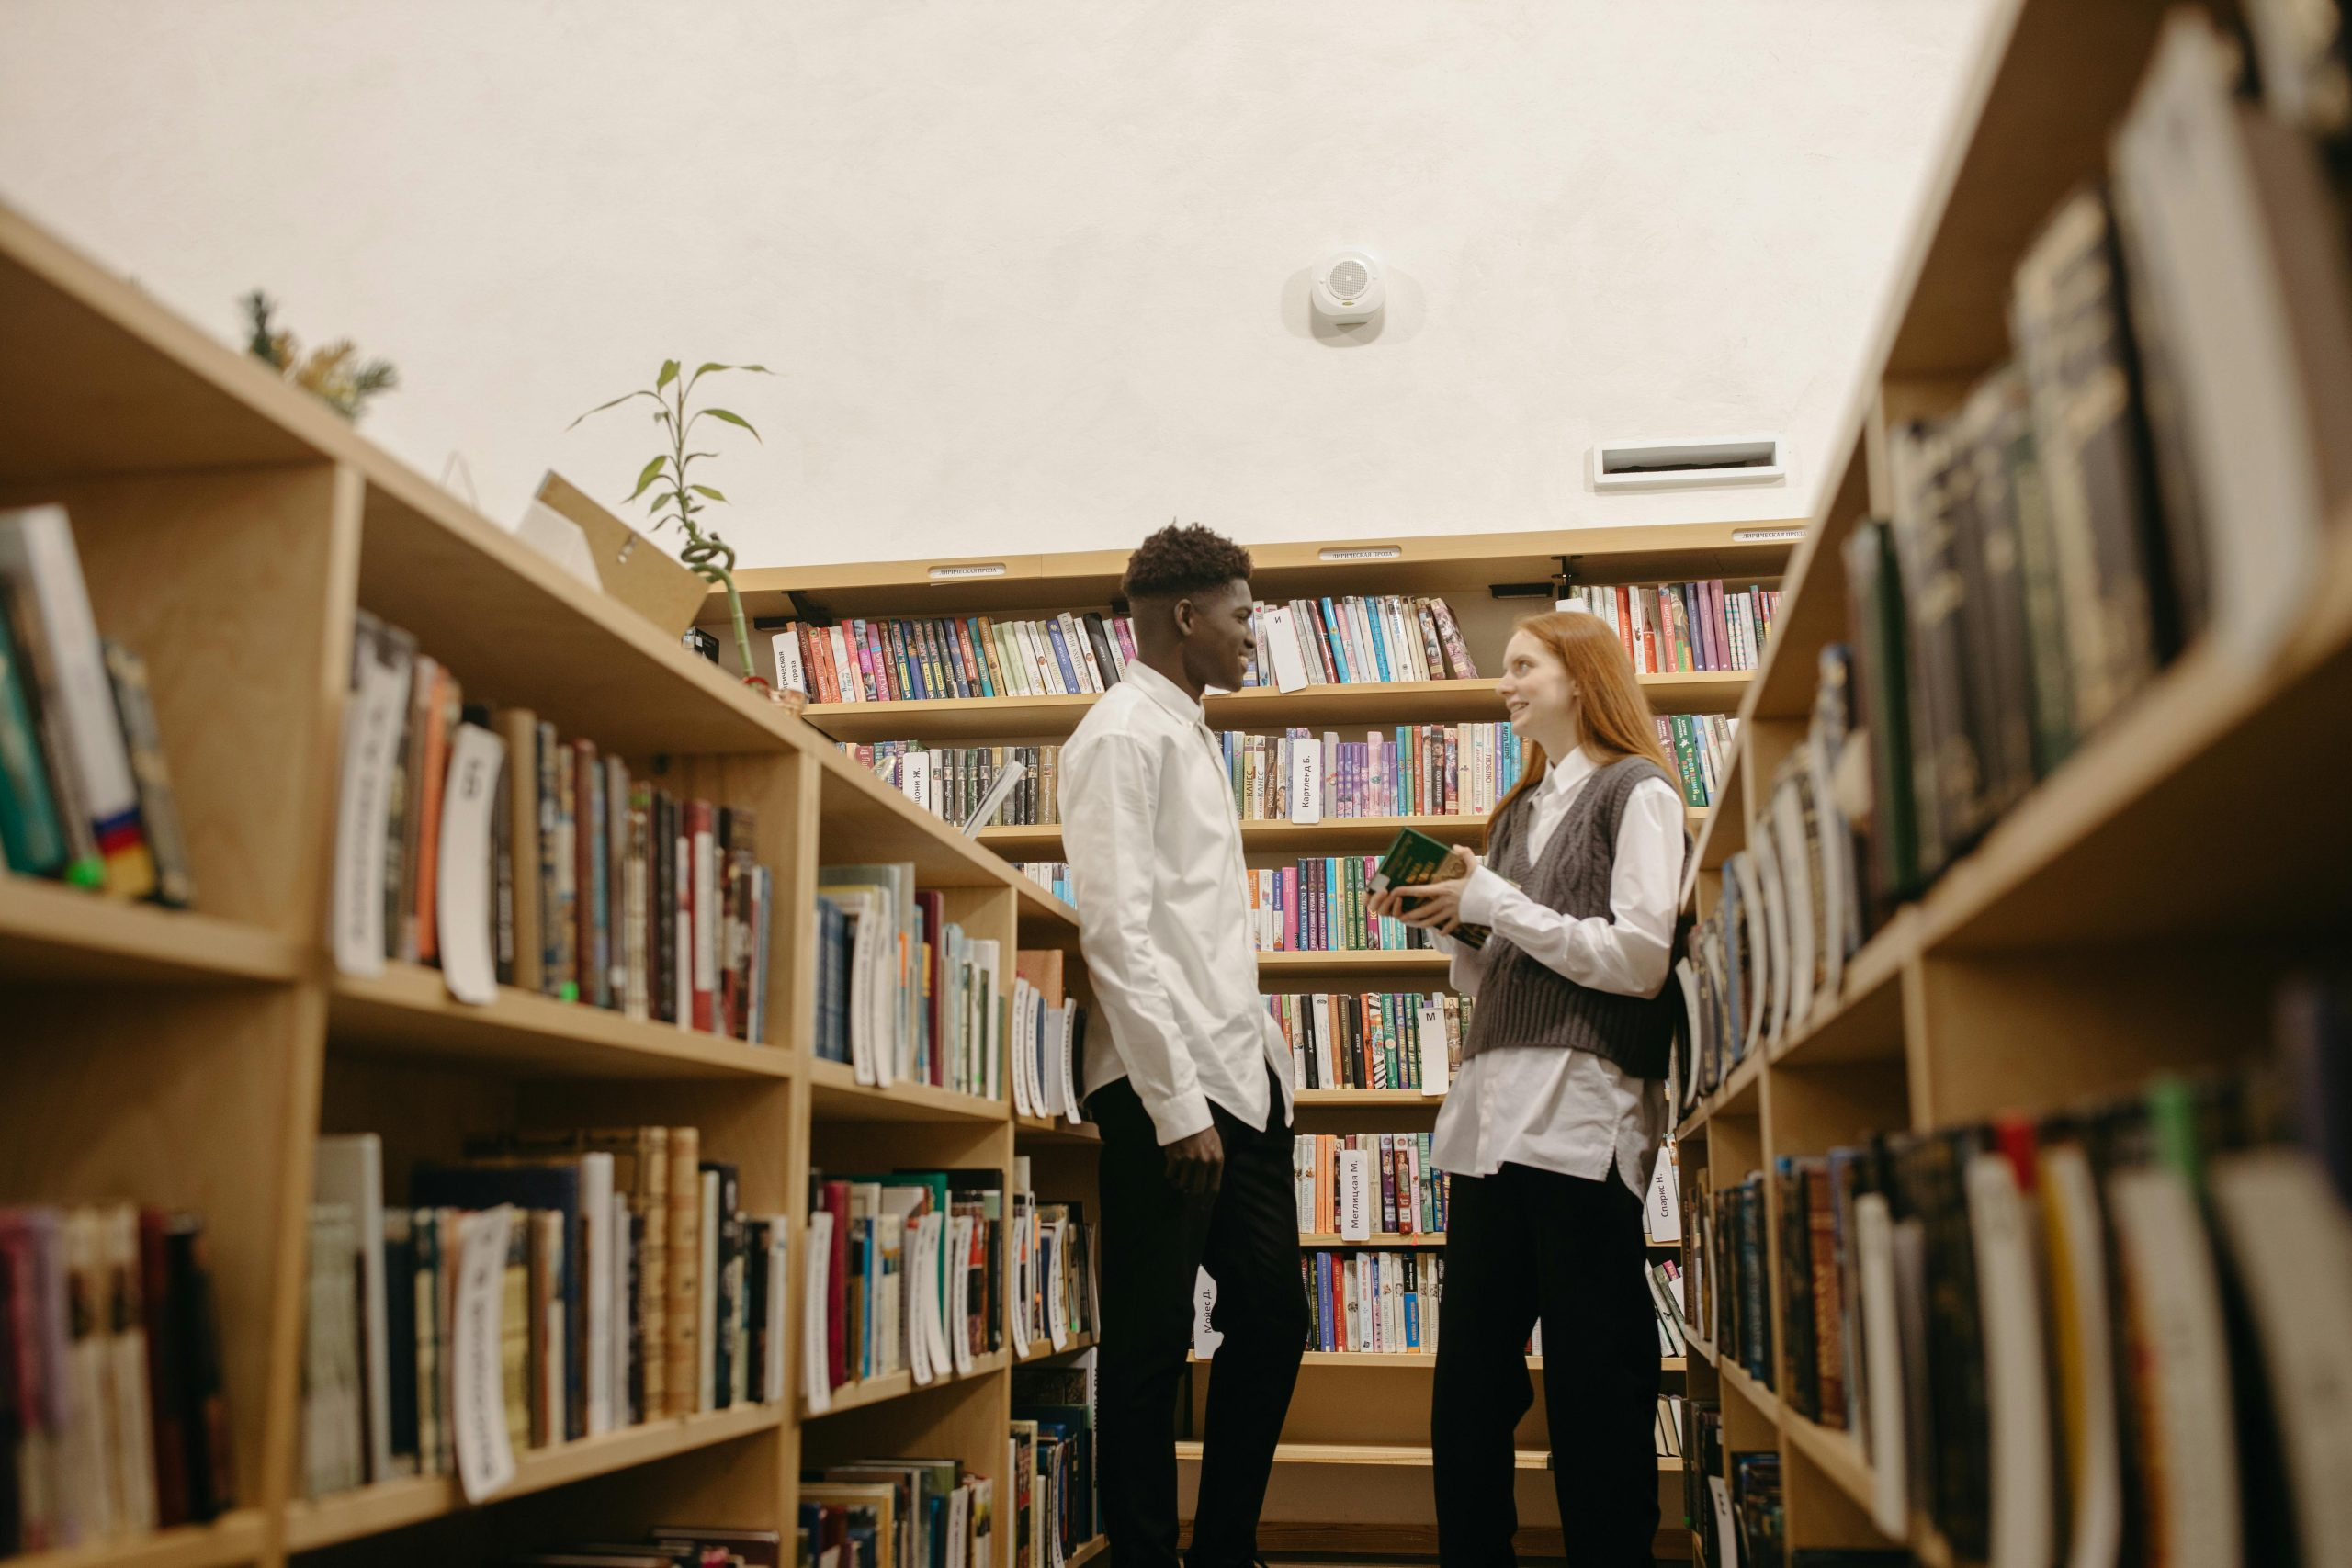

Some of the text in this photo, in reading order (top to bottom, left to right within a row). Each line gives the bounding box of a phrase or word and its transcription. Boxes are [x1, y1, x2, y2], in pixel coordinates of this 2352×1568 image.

[779, 651, 788, 688] рическая
[874, 653, 888, 695] АРСЕНЬЕВА
[913, 767, 922, 805] цони Ж.
[1302, 766, 1311, 807] Картленд
[1385, 999, 1393, 1036] Лукьянова
[1426, 1012, 1435, 1021] М
[1350, 1161, 1359, 1229] Метлицкая М.
[1656, 1173, 1669, 1217] Спаркс Н.
[1203, 1289, 1212, 1333] Мойес Д.
